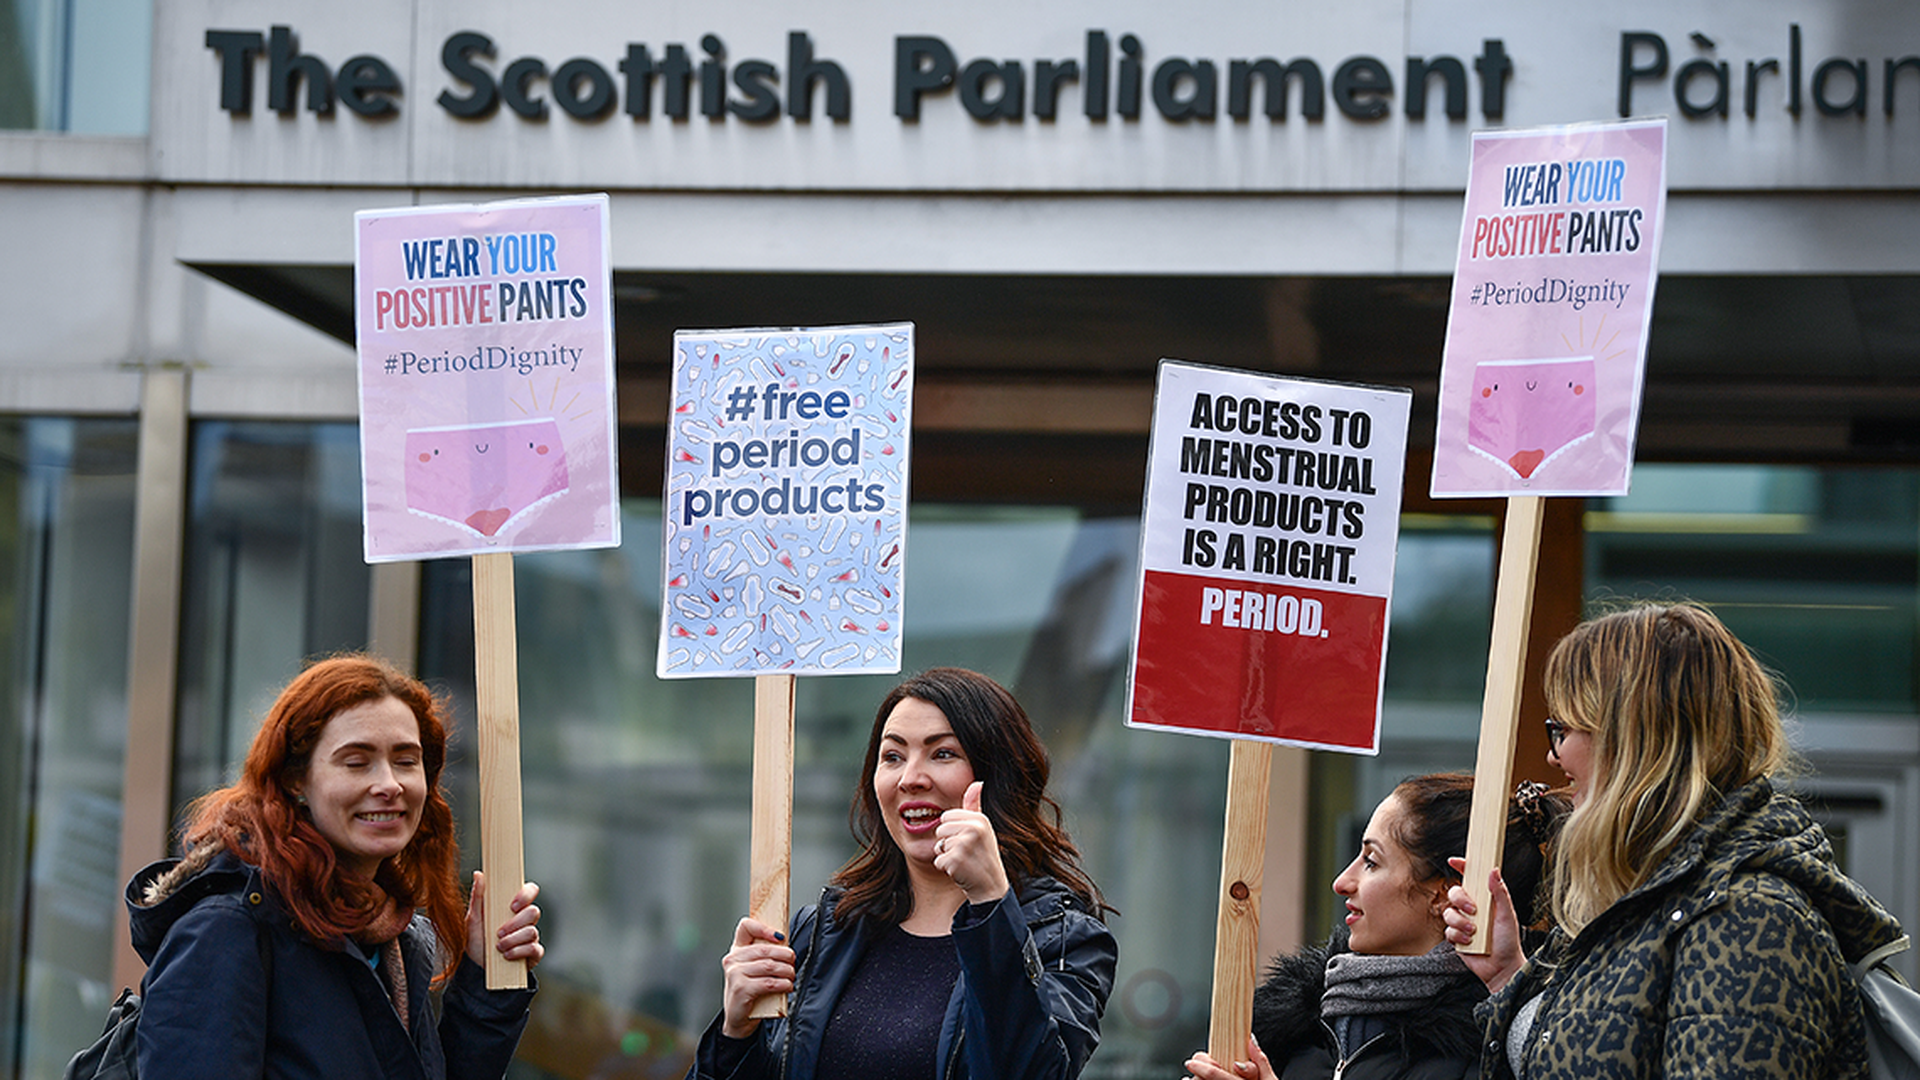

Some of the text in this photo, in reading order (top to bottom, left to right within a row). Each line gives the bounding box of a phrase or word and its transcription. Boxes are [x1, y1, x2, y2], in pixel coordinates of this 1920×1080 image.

[206, 26, 403, 119] The
[437, 30, 852, 124] Scottish
[894, 30, 1513, 124] Parliament
[1503, 159, 1626, 207] WEAR YOUR
[402, 232, 557, 281] WEAR YOUR
[1472, 208, 1643, 259] POSITIVE PANTS
[376, 277, 588, 331] POSITIVE PANTS
[1470, 277, 1631, 311] #PeriodDignity
[384, 343, 583, 376] #PeriodDignity
[1190, 392, 1371, 449] ACCESS TO
[712, 428, 861, 478] period
[1180, 436, 1377, 496] MENSTRUAL
[683, 477, 886, 527] products
[1183, 482, 1364, 540] PRODUCTS
[1182, 528, 1357, 585] IS A RIGHT.
[1200, 586, 1330, 639] PERIOD.
